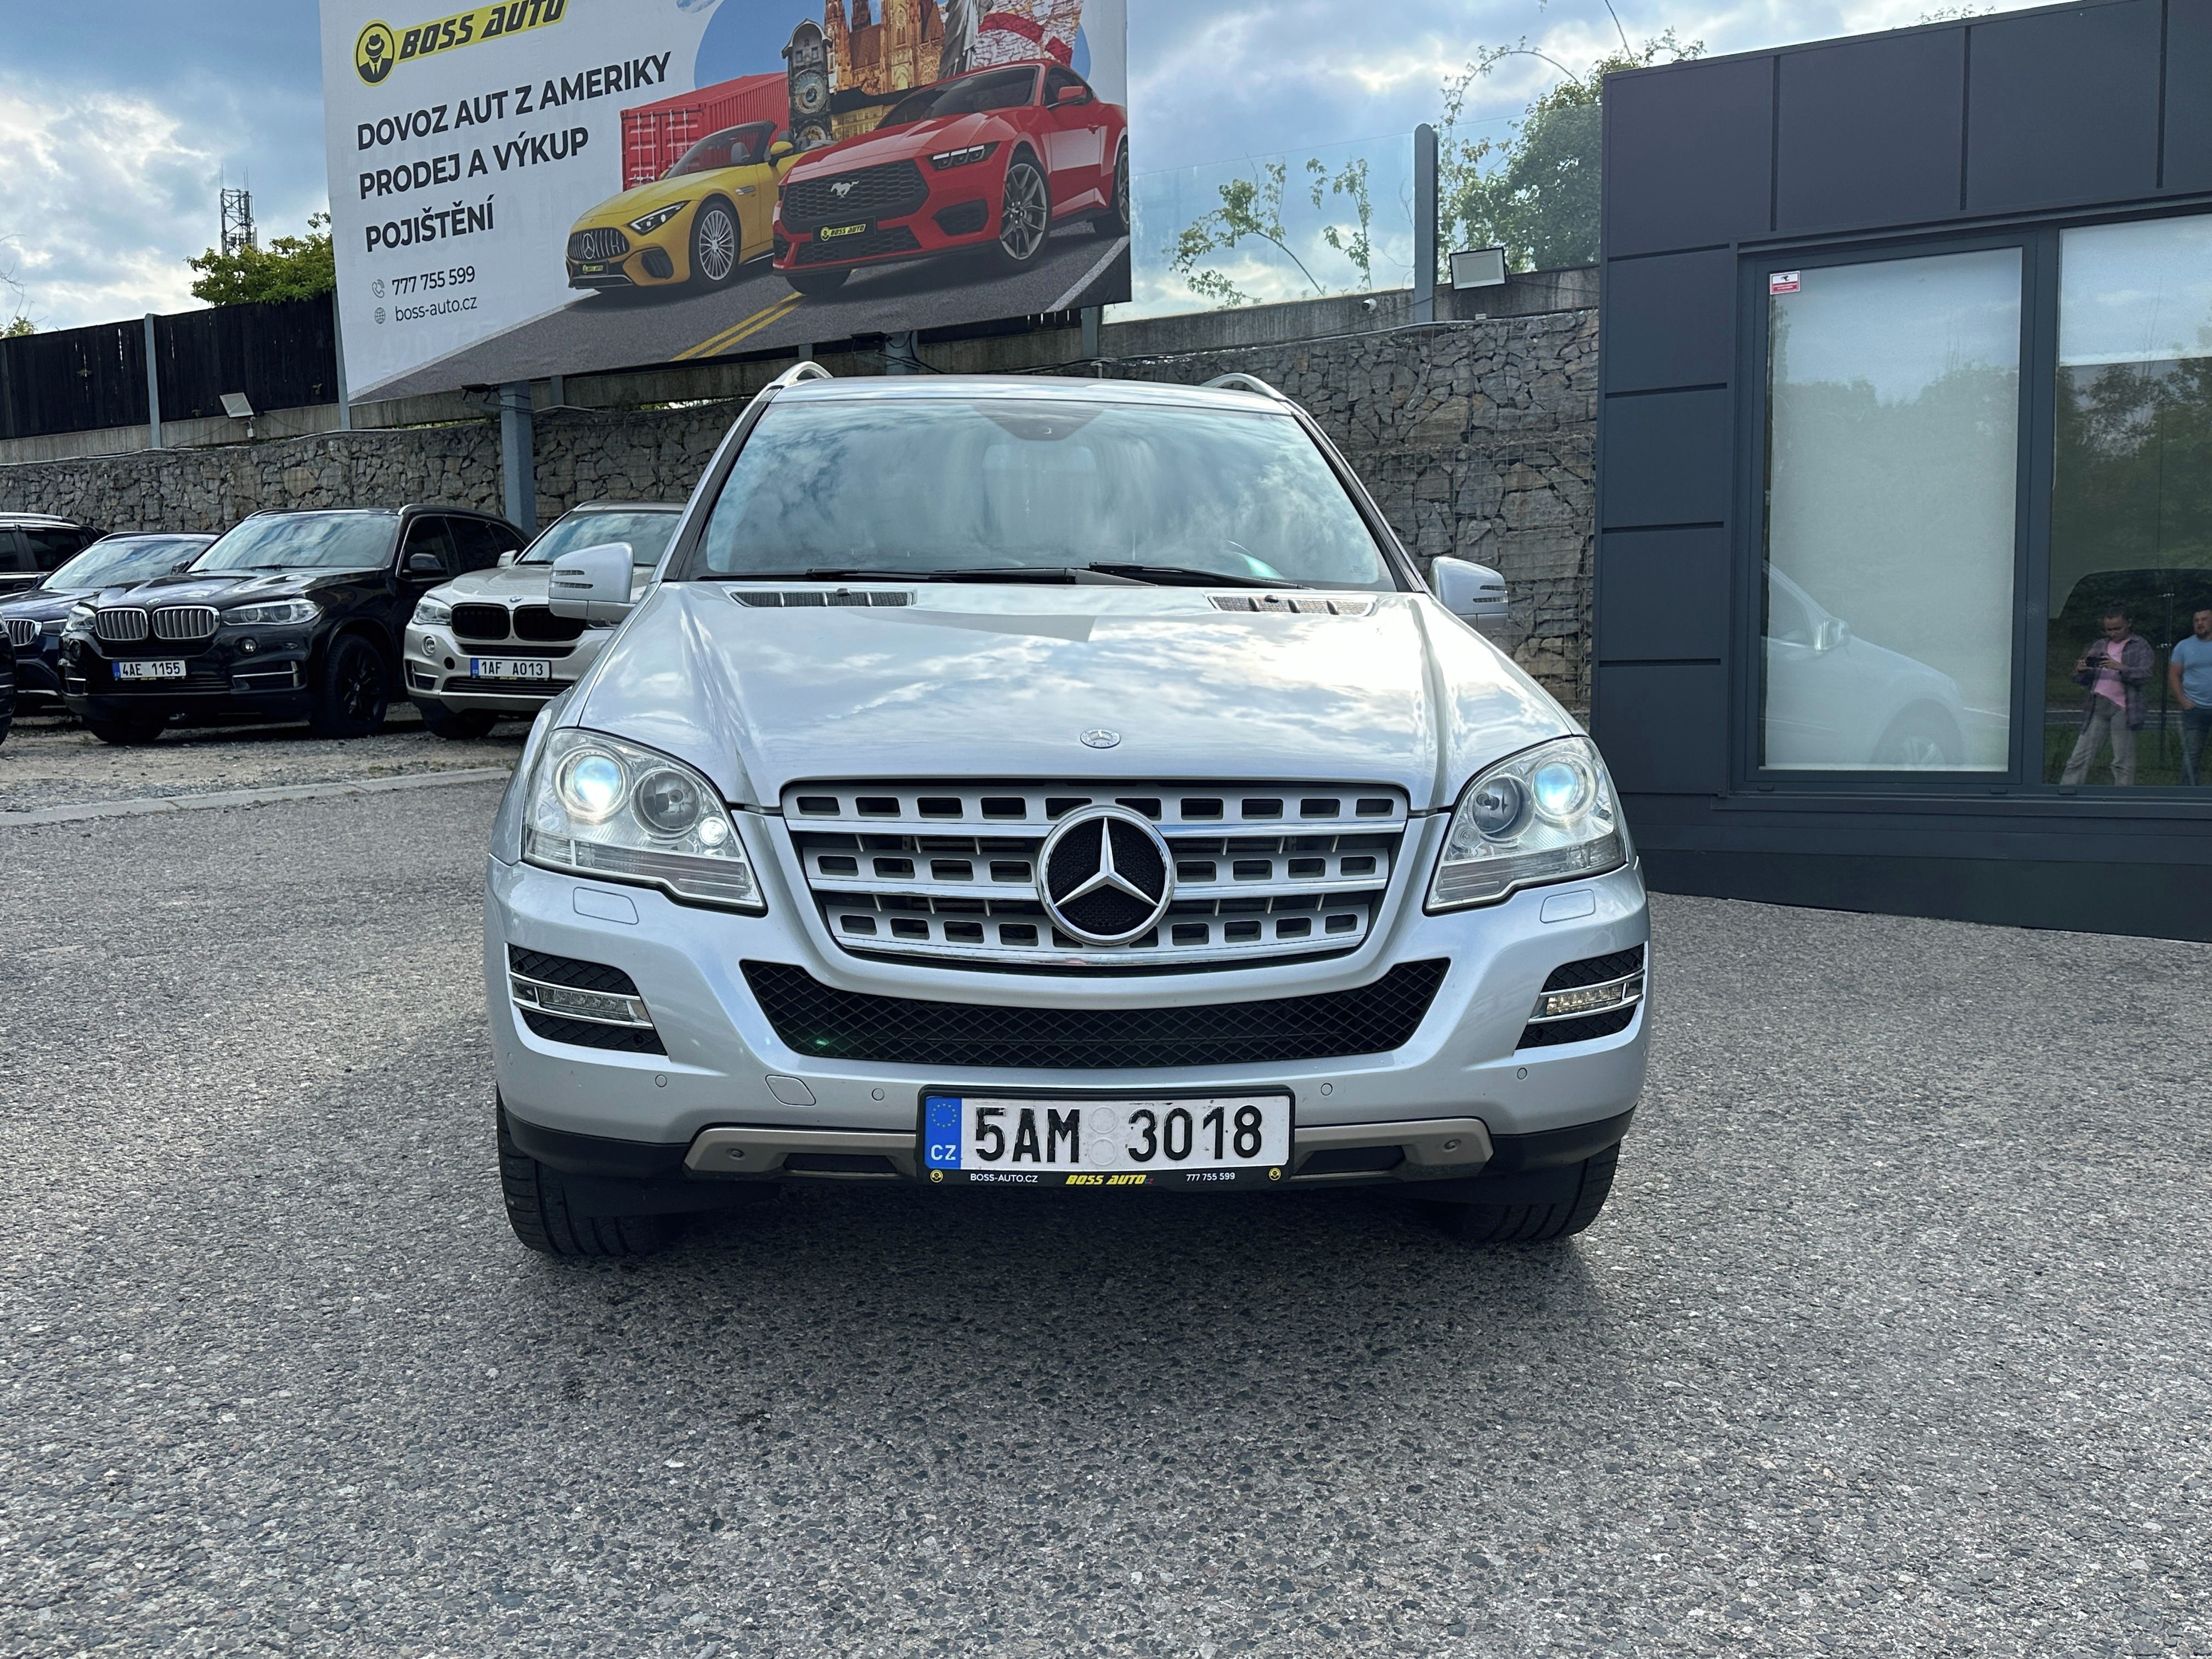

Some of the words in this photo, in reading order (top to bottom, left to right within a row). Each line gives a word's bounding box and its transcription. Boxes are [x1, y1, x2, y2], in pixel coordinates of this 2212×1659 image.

[399, 14, 475, 60] BOSS
[480, 0, 563, 39] AUTO
[358, 104, 449, 151] DOVOZ
[454, 89, 509, 129] AUT
[515, 84, 533, 115] Z
[539, 51, 671, 110] AMERIKY
[360, 153, 460, 200] PRODEJ
[467, 149, 488, 178] A
[493, 127, 589, 171] VÝKUP
[365, 194, 495, 252] POJIŠTĚNÍ
[831, 228, 846, 236] BOSS
[848, 225, 865, 234] AUTO
[392, 276, 417, 296] 777
[420, 270, 445, 291] 755
[449, 266, 475, 286] 599
[394, 297, 478, 322] boss-auto.cz
[122, 663, 143, 676] 4AE
[151, 662, 180, 675] 1155
[482, 661, 503, 674] 1AF
[512, 662, 543, 676] A013
[975, 1105, 1081, 1163] 5AM
[1127, 1104, 1263, 1162] 3018
[930, 1144, 957, 1161] CZ
[970, 1173, 1039, 1183] BOSS-AUTO.CZ
[1065, 1175, 1104, 1185] BOSS
[1186, 1173, 1200, 1182] 777
[1202, 1173, 1217, 1181] 755
[1220, 1172, 1235, 1180] 599
